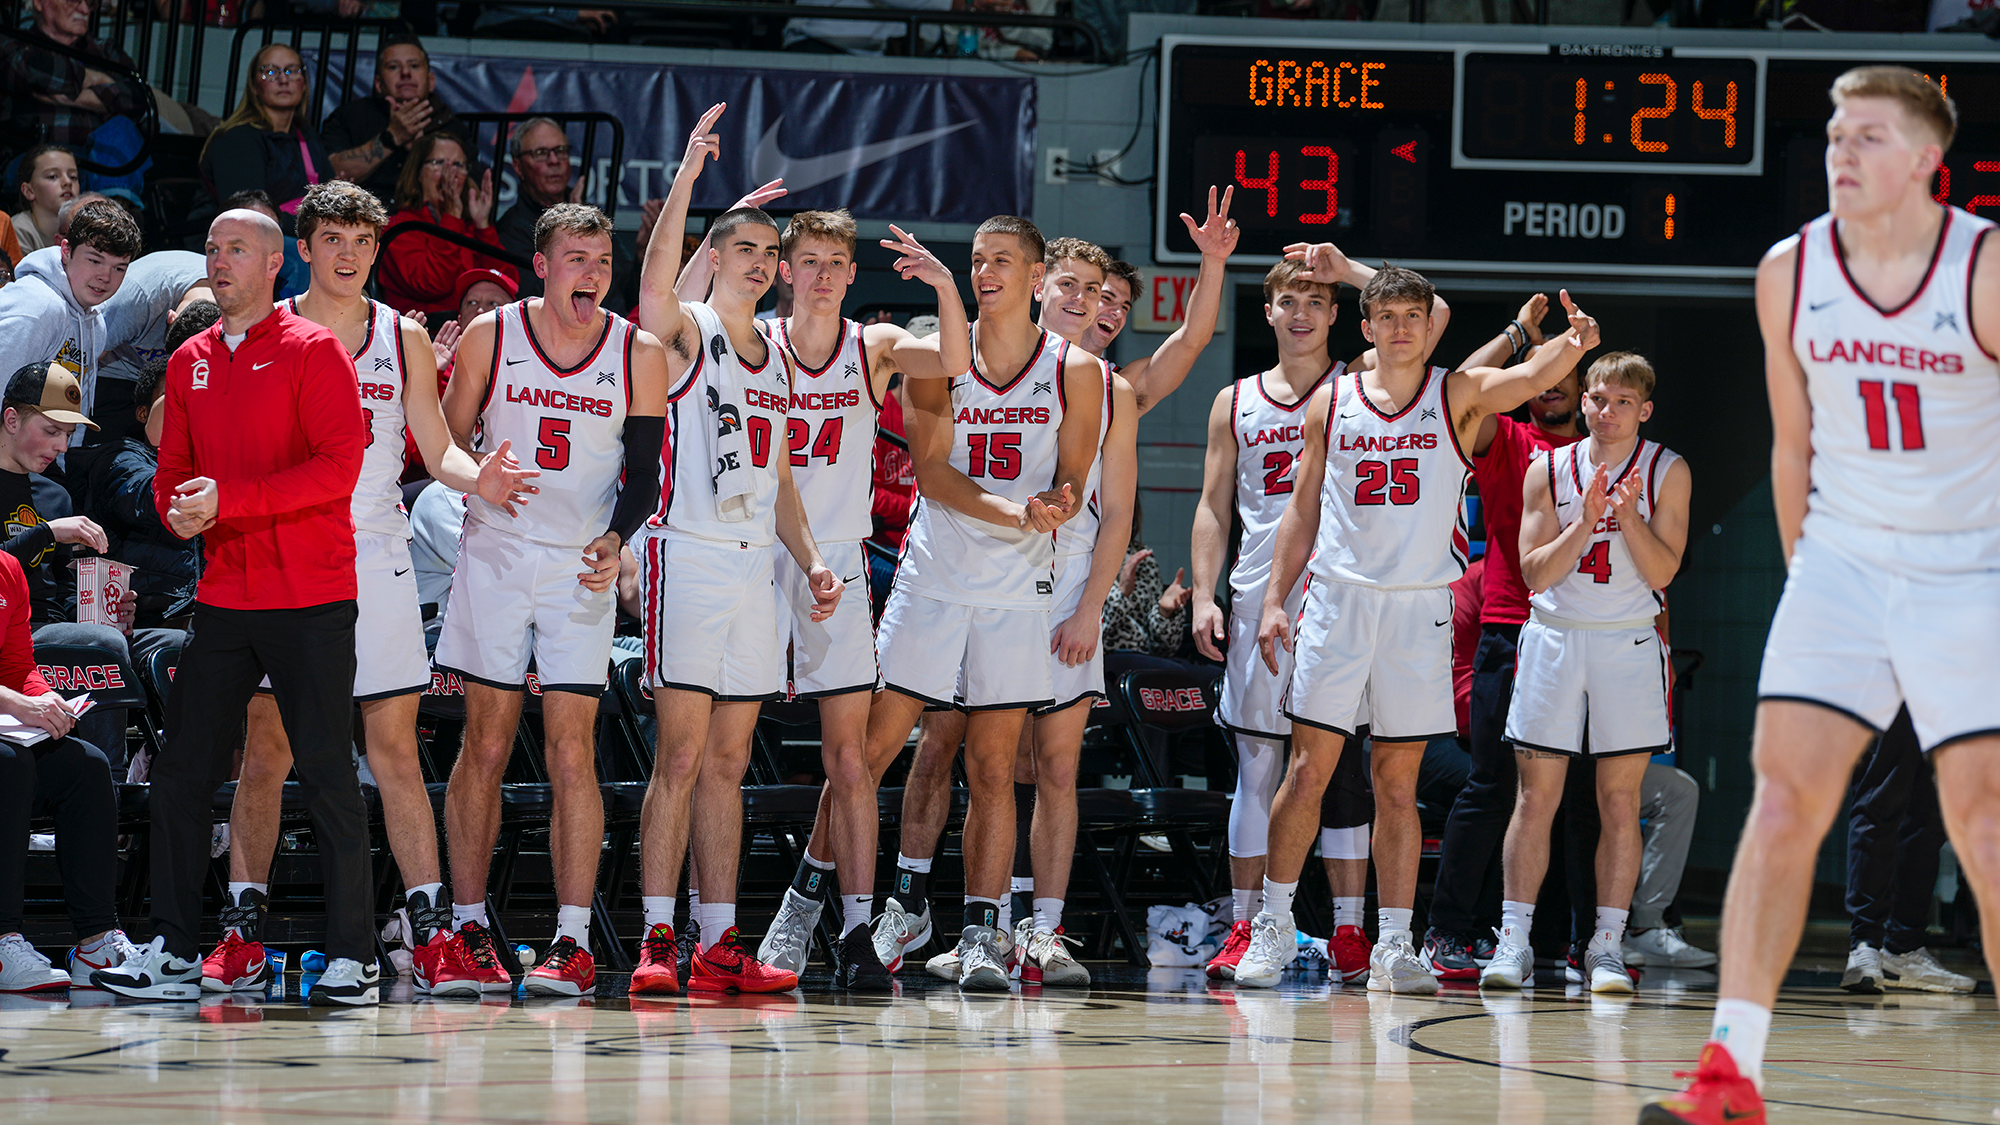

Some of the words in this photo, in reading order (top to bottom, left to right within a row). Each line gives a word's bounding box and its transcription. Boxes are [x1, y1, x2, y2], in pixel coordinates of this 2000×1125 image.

[1559, 43, 1665, 58] DAKTRONICS
[1249, 59, 1386, 109] GRACE
[1574, 72, 1738, 153] 1:24
[1234, 145, 1339, 225] 43
[1503, 201, 1626, 240] PERIOD
[1664, 193, 1676, 240] 1
[1153, 276, 1197, 323] EX
[1807, 338, 1964, 375] LANCERS
[506, 384, 613, 418] LANCERS
[745, 387, 788, 415] CERS
[790, 389, 860, 410] NCERS
[954, 406, 1050, 425] ANCERS
[1857, 376, 1926, 452] 11
[535, 416, 571, 472] 5
[786, 415, 844, 468] 24
[967, 432, 1022, 481] 15
[1243, 424, 1305, 448] LANC
[1339, 433, 1438, 453] LANCERS
[1263, 450, 1303, 496] 2
[1355, 457, 1421, 506] 25
[1576, 539, 1613, 585] 4
[105, 600, 121, 618] CO
[37, 664, 126, 691] GRACE
[1140, 687, 1207, 712] GRACE
